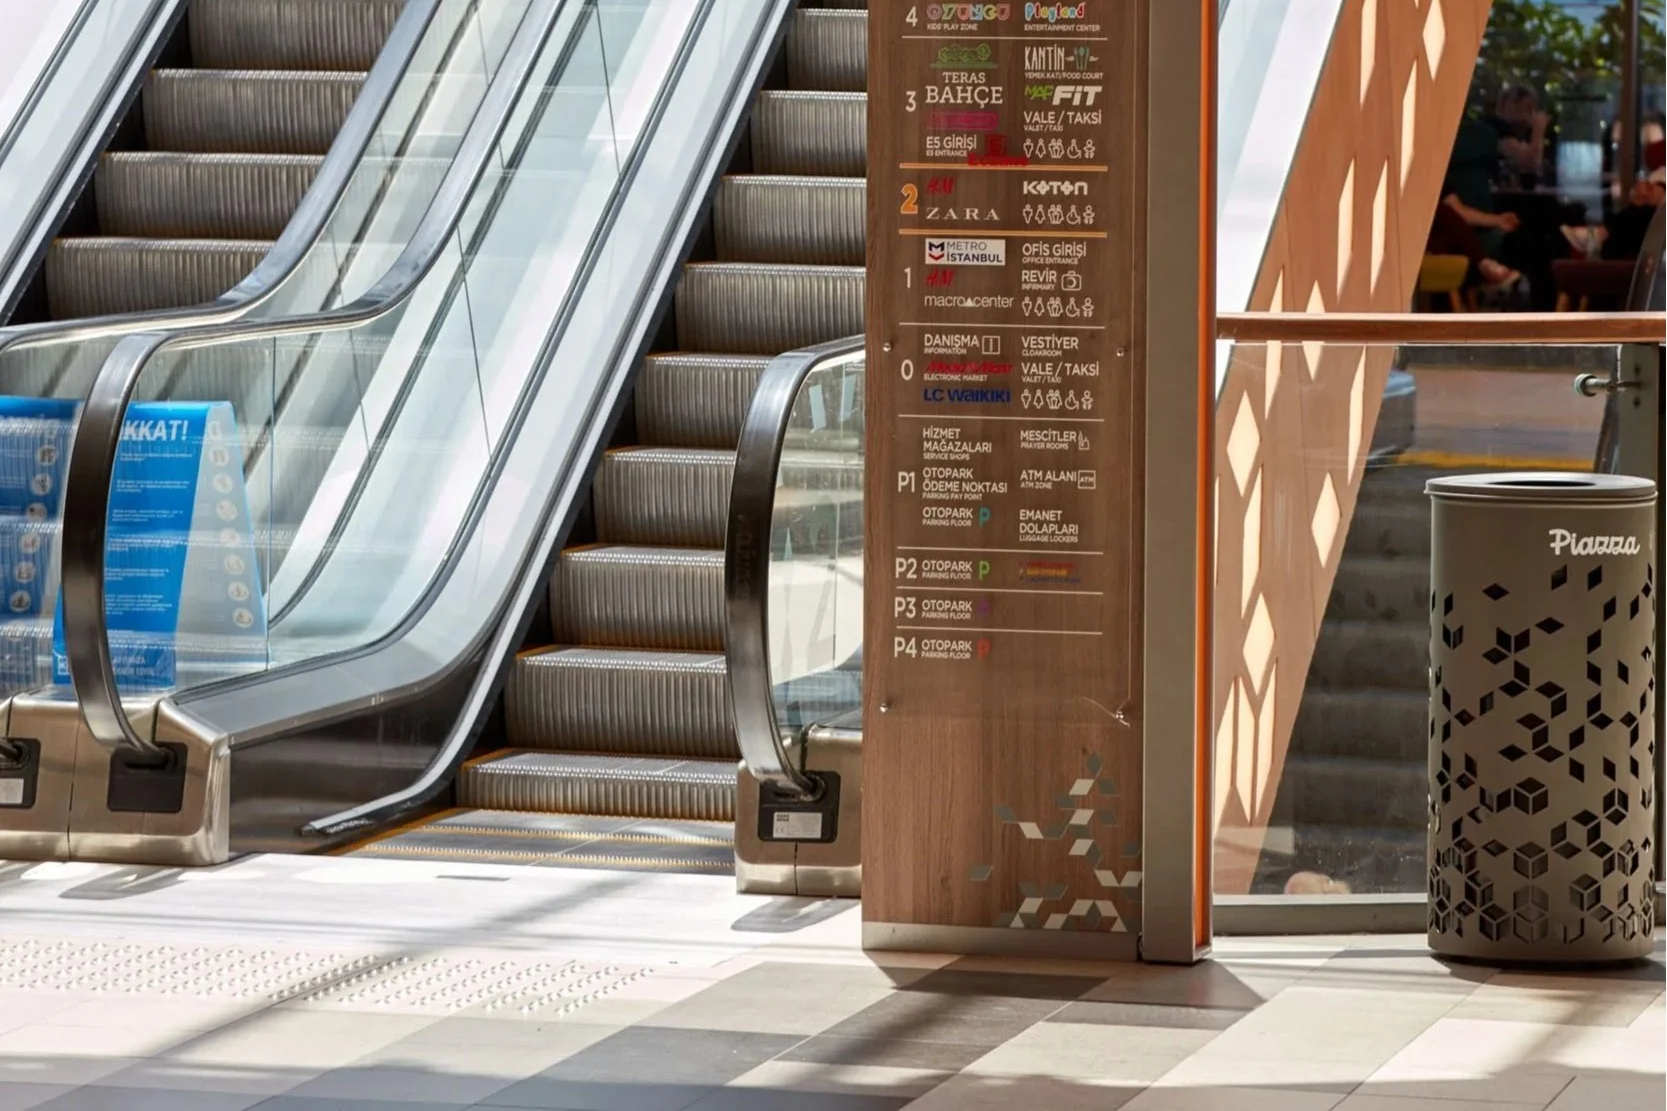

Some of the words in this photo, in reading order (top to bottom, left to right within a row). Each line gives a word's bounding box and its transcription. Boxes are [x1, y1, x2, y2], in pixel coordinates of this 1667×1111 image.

[906, 6, 918, 27] 4
[1024, 2, 1086, 22] Playland
[943, 23, 960, 31] PLAY
[960, 23, 978, 31] ZONE
[1024, 24, 1075, 32] ENTERTAINMENT
[1076, 24, 1100, 32] CENTER
[1024, 44, 1065, 71] KANTİN
[943, 72, 985, 84] TERAS
[1083, 72, 1103, 80] COURT
[905, 91, 916, 112] 3
[925, 86, 1003, 108] BAHÇE
[1024, 111, 1056, 124] VALE
[1067, 109, 1102, 124] TAKSİ
[926, 136, 941, 148] E5
[943, 134, 977, 150] GİRİŞİ
[901, 183, 918, 214] 2
[926, 207, 1000, 220] ZARA
[947, 241, 987, 251] METRO
[1022, 242, 1049, 256] OFİS
[1052, 241, 1087, 258] GİRİŞİ
[947, 251, 1003, 263] İSTANBUL
[904, 267, 911, 288] 1
[1022, 269, 1057, 283] REVİR
[924, 334, 979, 349] DANIŞMA
[1022, 334, 1078, 349] VESTİYER
[1022, 349, 1062, 357] CLOAKROOM
[1021, 362, 1053, 376] VALE
[1065, 361, 1099, 376] TAKSİ
[924, 373, 962, 381] ELECTRONIC
[963, 374, 988, 382] MARKET
[923, 389, 943, 402] LC
[923, 425, 960, 439] HİZMET
[1020, 428, 1077, 442] MESCİTLER
[923, 438, 992, 453] MAĞAZALARI
[1021, 441, 1045, 449] PRAYER
[923, 452, 949, 460] SERVICE
[922, 467, 973, 479] OTOPARK
[1020, 470, 1043, 481] ATM
[1045, 470, 1077, 482] ALANI
[898, 472, 915, 493] P1
[922, 480, 959, 492] ÖDEME
[962, 482, 1007, 493] NOKTASI
[1020, 481, 1034, 489] ATM
[922, 492, 949, 500] PARKING
[922, 507, 973, 519] OTOPARK
[1020, 509, 1063, 521] EMANET
[922, 518, 949, 526] PARKING
[1019, 523, 1079, 535] DOLAPLARI
[1549, 528, 1641, 555] Piazza
[896, 557, 917, 579] P2
[922, 560, 973, 572] OTOPARK
[922, 571, 948, 579] PARKING
[895, 597, 916, 618] P3
[922, 600, 973, 612] OTOPARK
[921, 611, 948, 619] PARKING
[894, 637, 917, 658] P4
[921, 639, 972, 652] OTOPARK
[921, 651, 948, 659] PARKING
